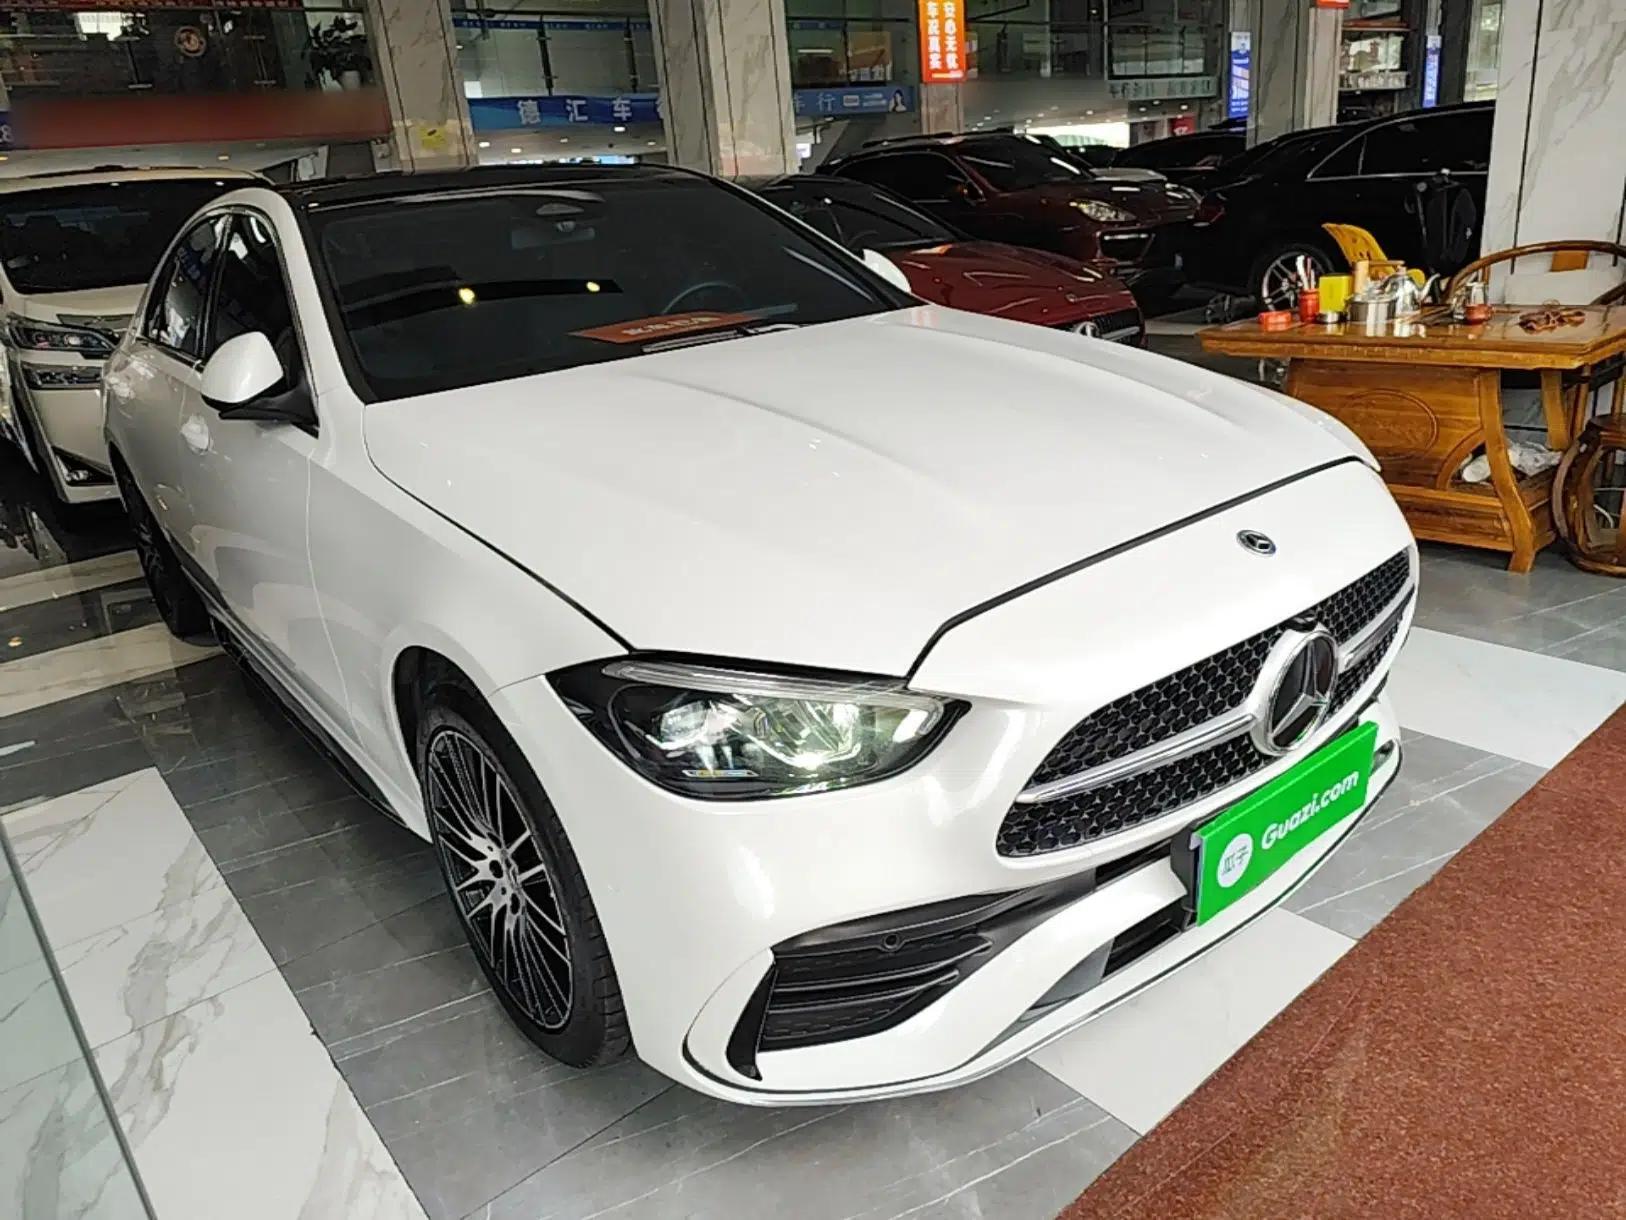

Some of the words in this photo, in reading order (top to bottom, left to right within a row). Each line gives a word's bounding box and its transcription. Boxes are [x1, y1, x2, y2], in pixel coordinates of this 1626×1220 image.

[517, 96, 664, 125] 德汇车
[1261, 771, 1359, 850] Guazi.com
